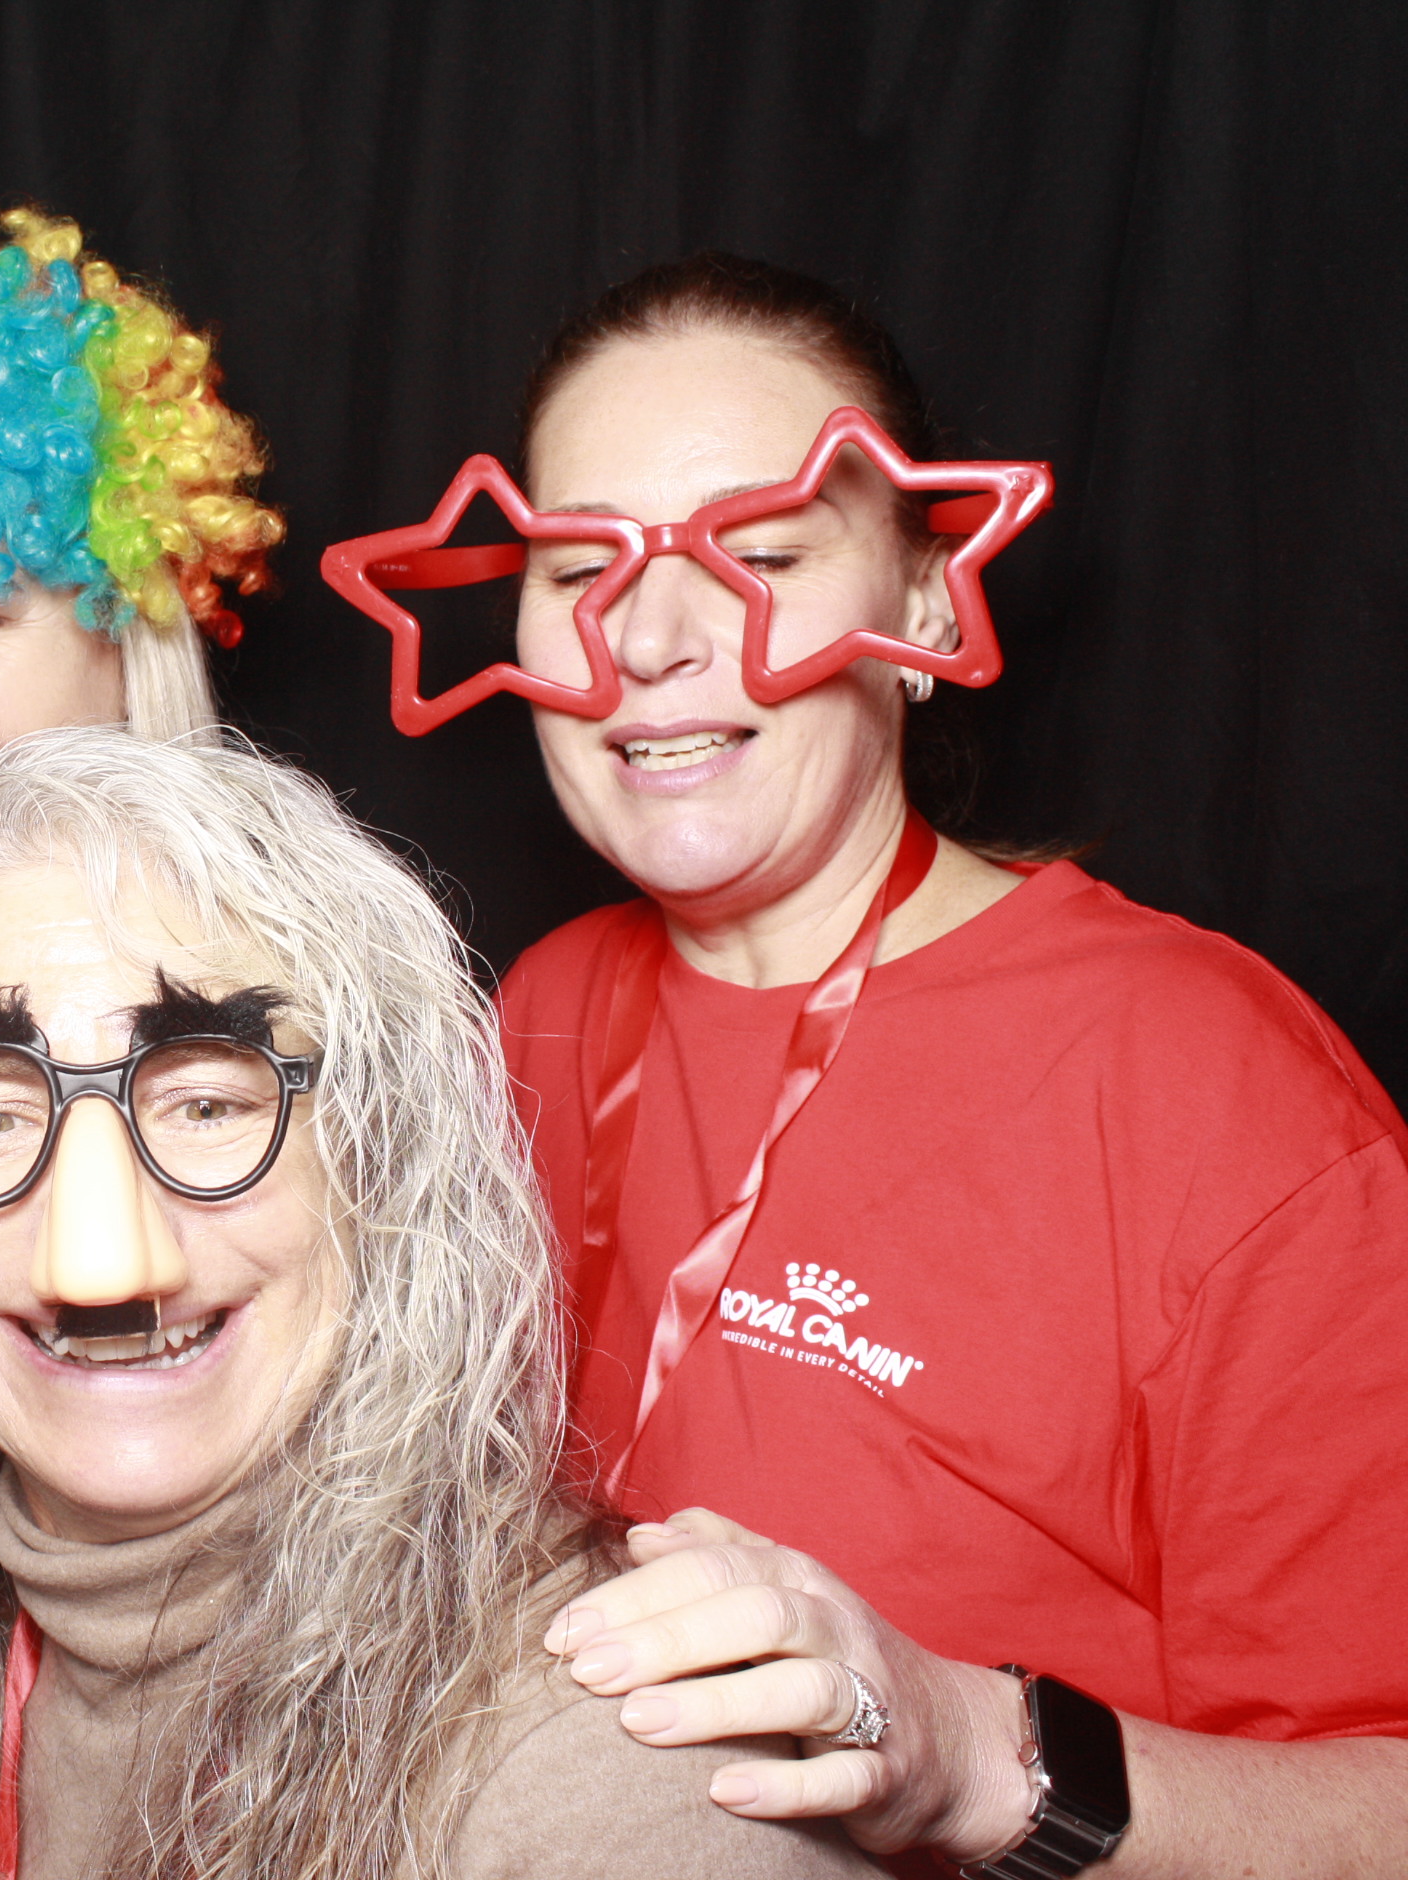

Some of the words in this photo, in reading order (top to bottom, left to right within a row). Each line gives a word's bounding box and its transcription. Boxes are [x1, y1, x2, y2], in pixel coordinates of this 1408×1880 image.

[720, 1288, 796, 1337] ROYAL
[780, 1346, 794, 1359] IN
[797, 1351, 835, 1368] EVERY
[838, 1363, 885, 1398] DETAIL
